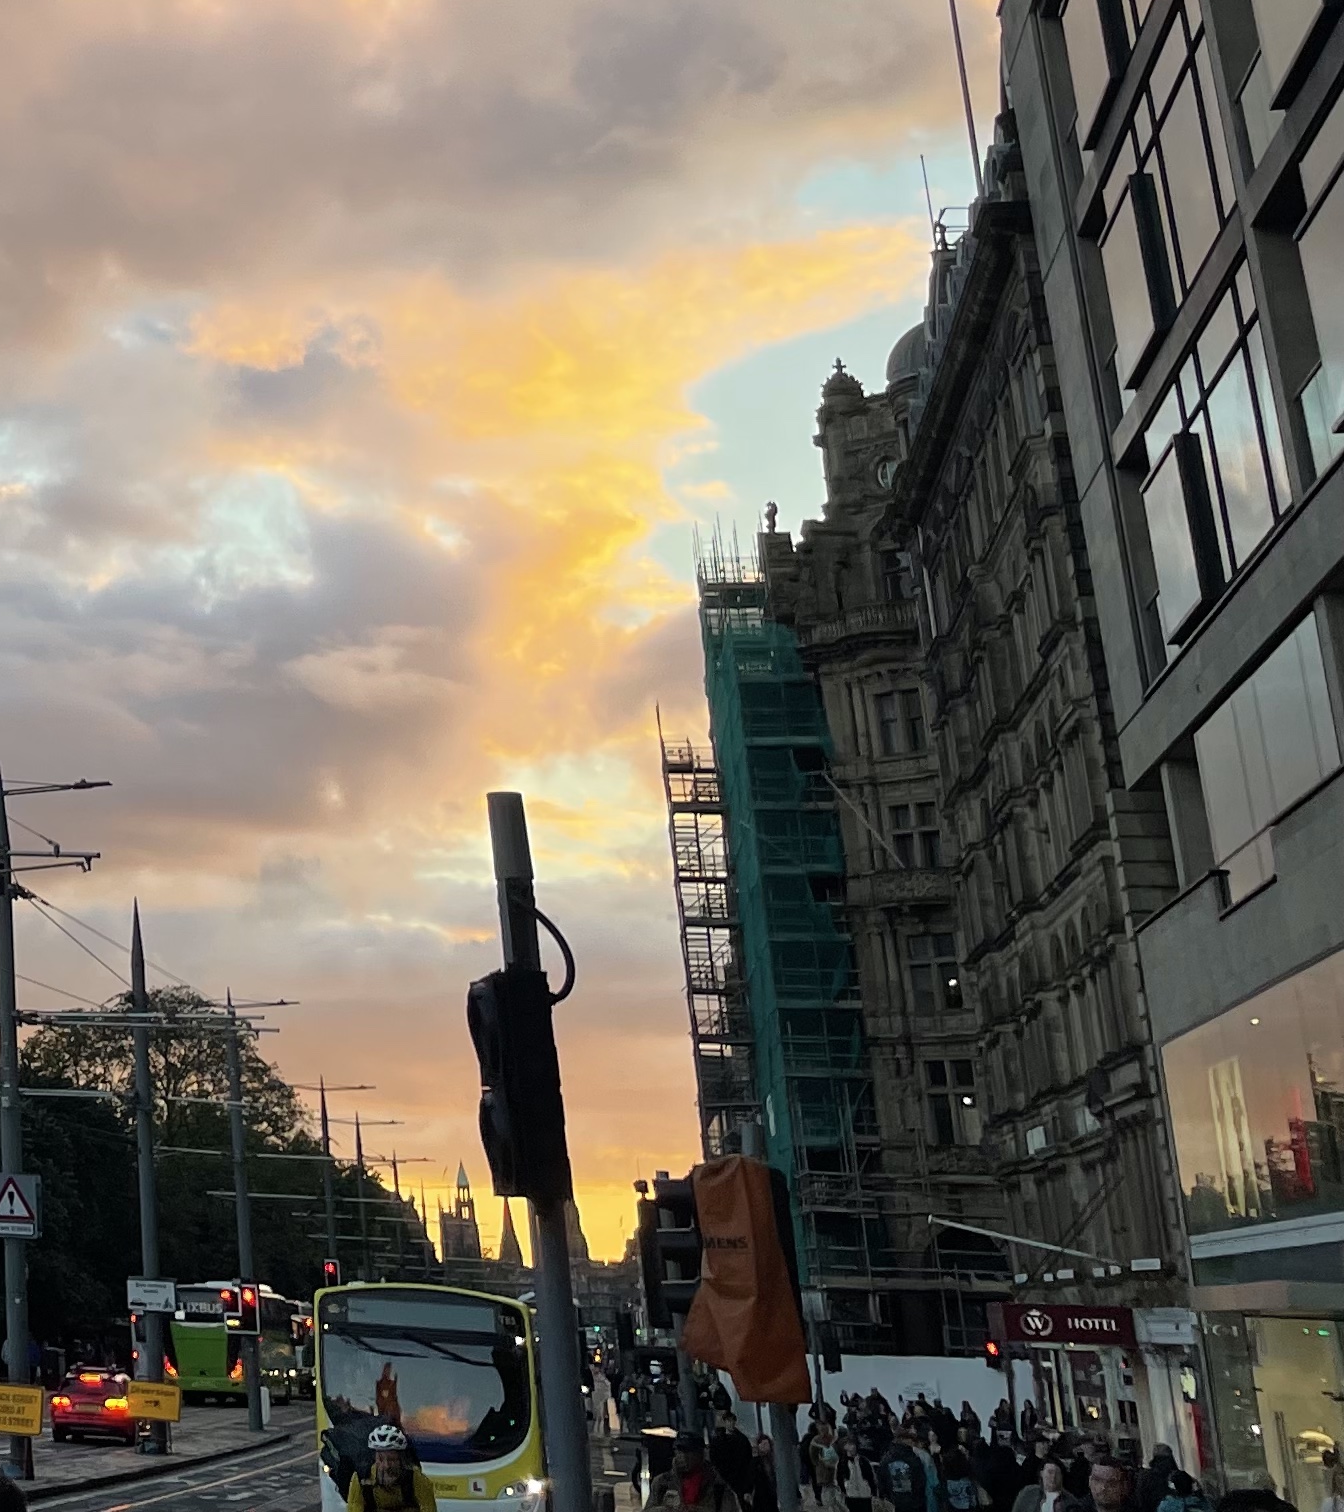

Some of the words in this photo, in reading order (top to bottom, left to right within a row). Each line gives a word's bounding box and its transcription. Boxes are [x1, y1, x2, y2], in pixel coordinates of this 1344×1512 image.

[177, 1301, 223, 1314] LIXBUS
[1067, 1317, 1119, 1333] HOTEL
[15, 1406, 25, 1415] AT
[473, 1481, 483, 1492] L
